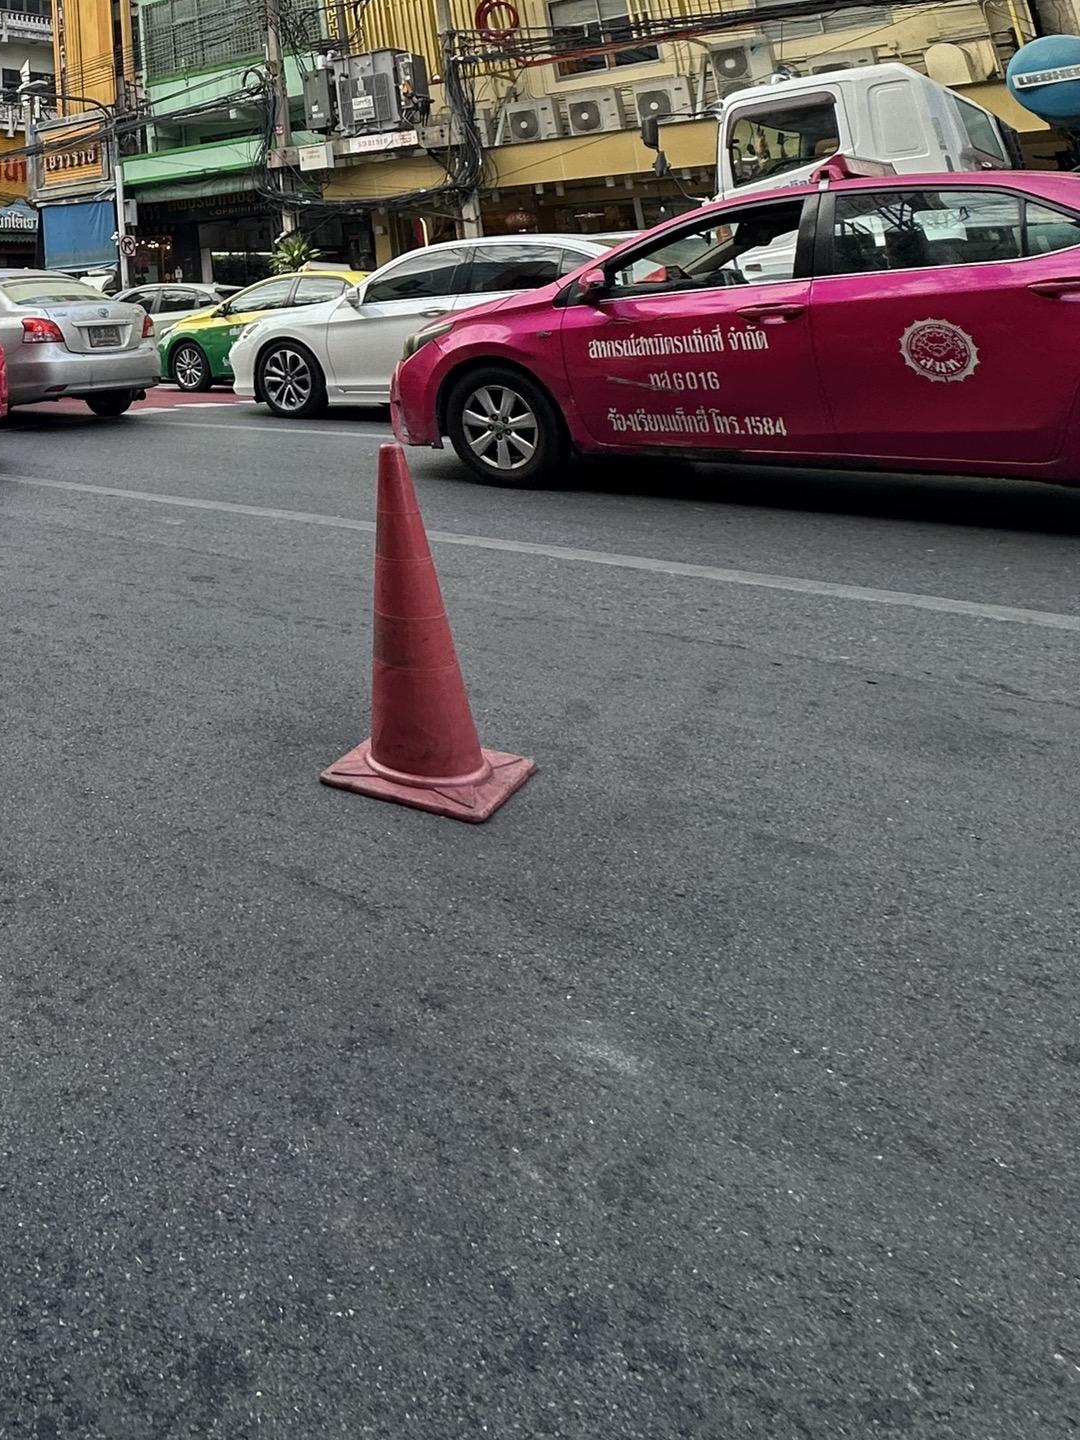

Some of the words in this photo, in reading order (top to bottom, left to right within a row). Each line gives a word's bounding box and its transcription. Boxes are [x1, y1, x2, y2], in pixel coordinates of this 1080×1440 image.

[1017, 66, 1080, 86] LIEBHE
[728, 325, 770, 351] จำกัด
[607, 407, 710, 433] ร้องเรียนแท็กซี่
